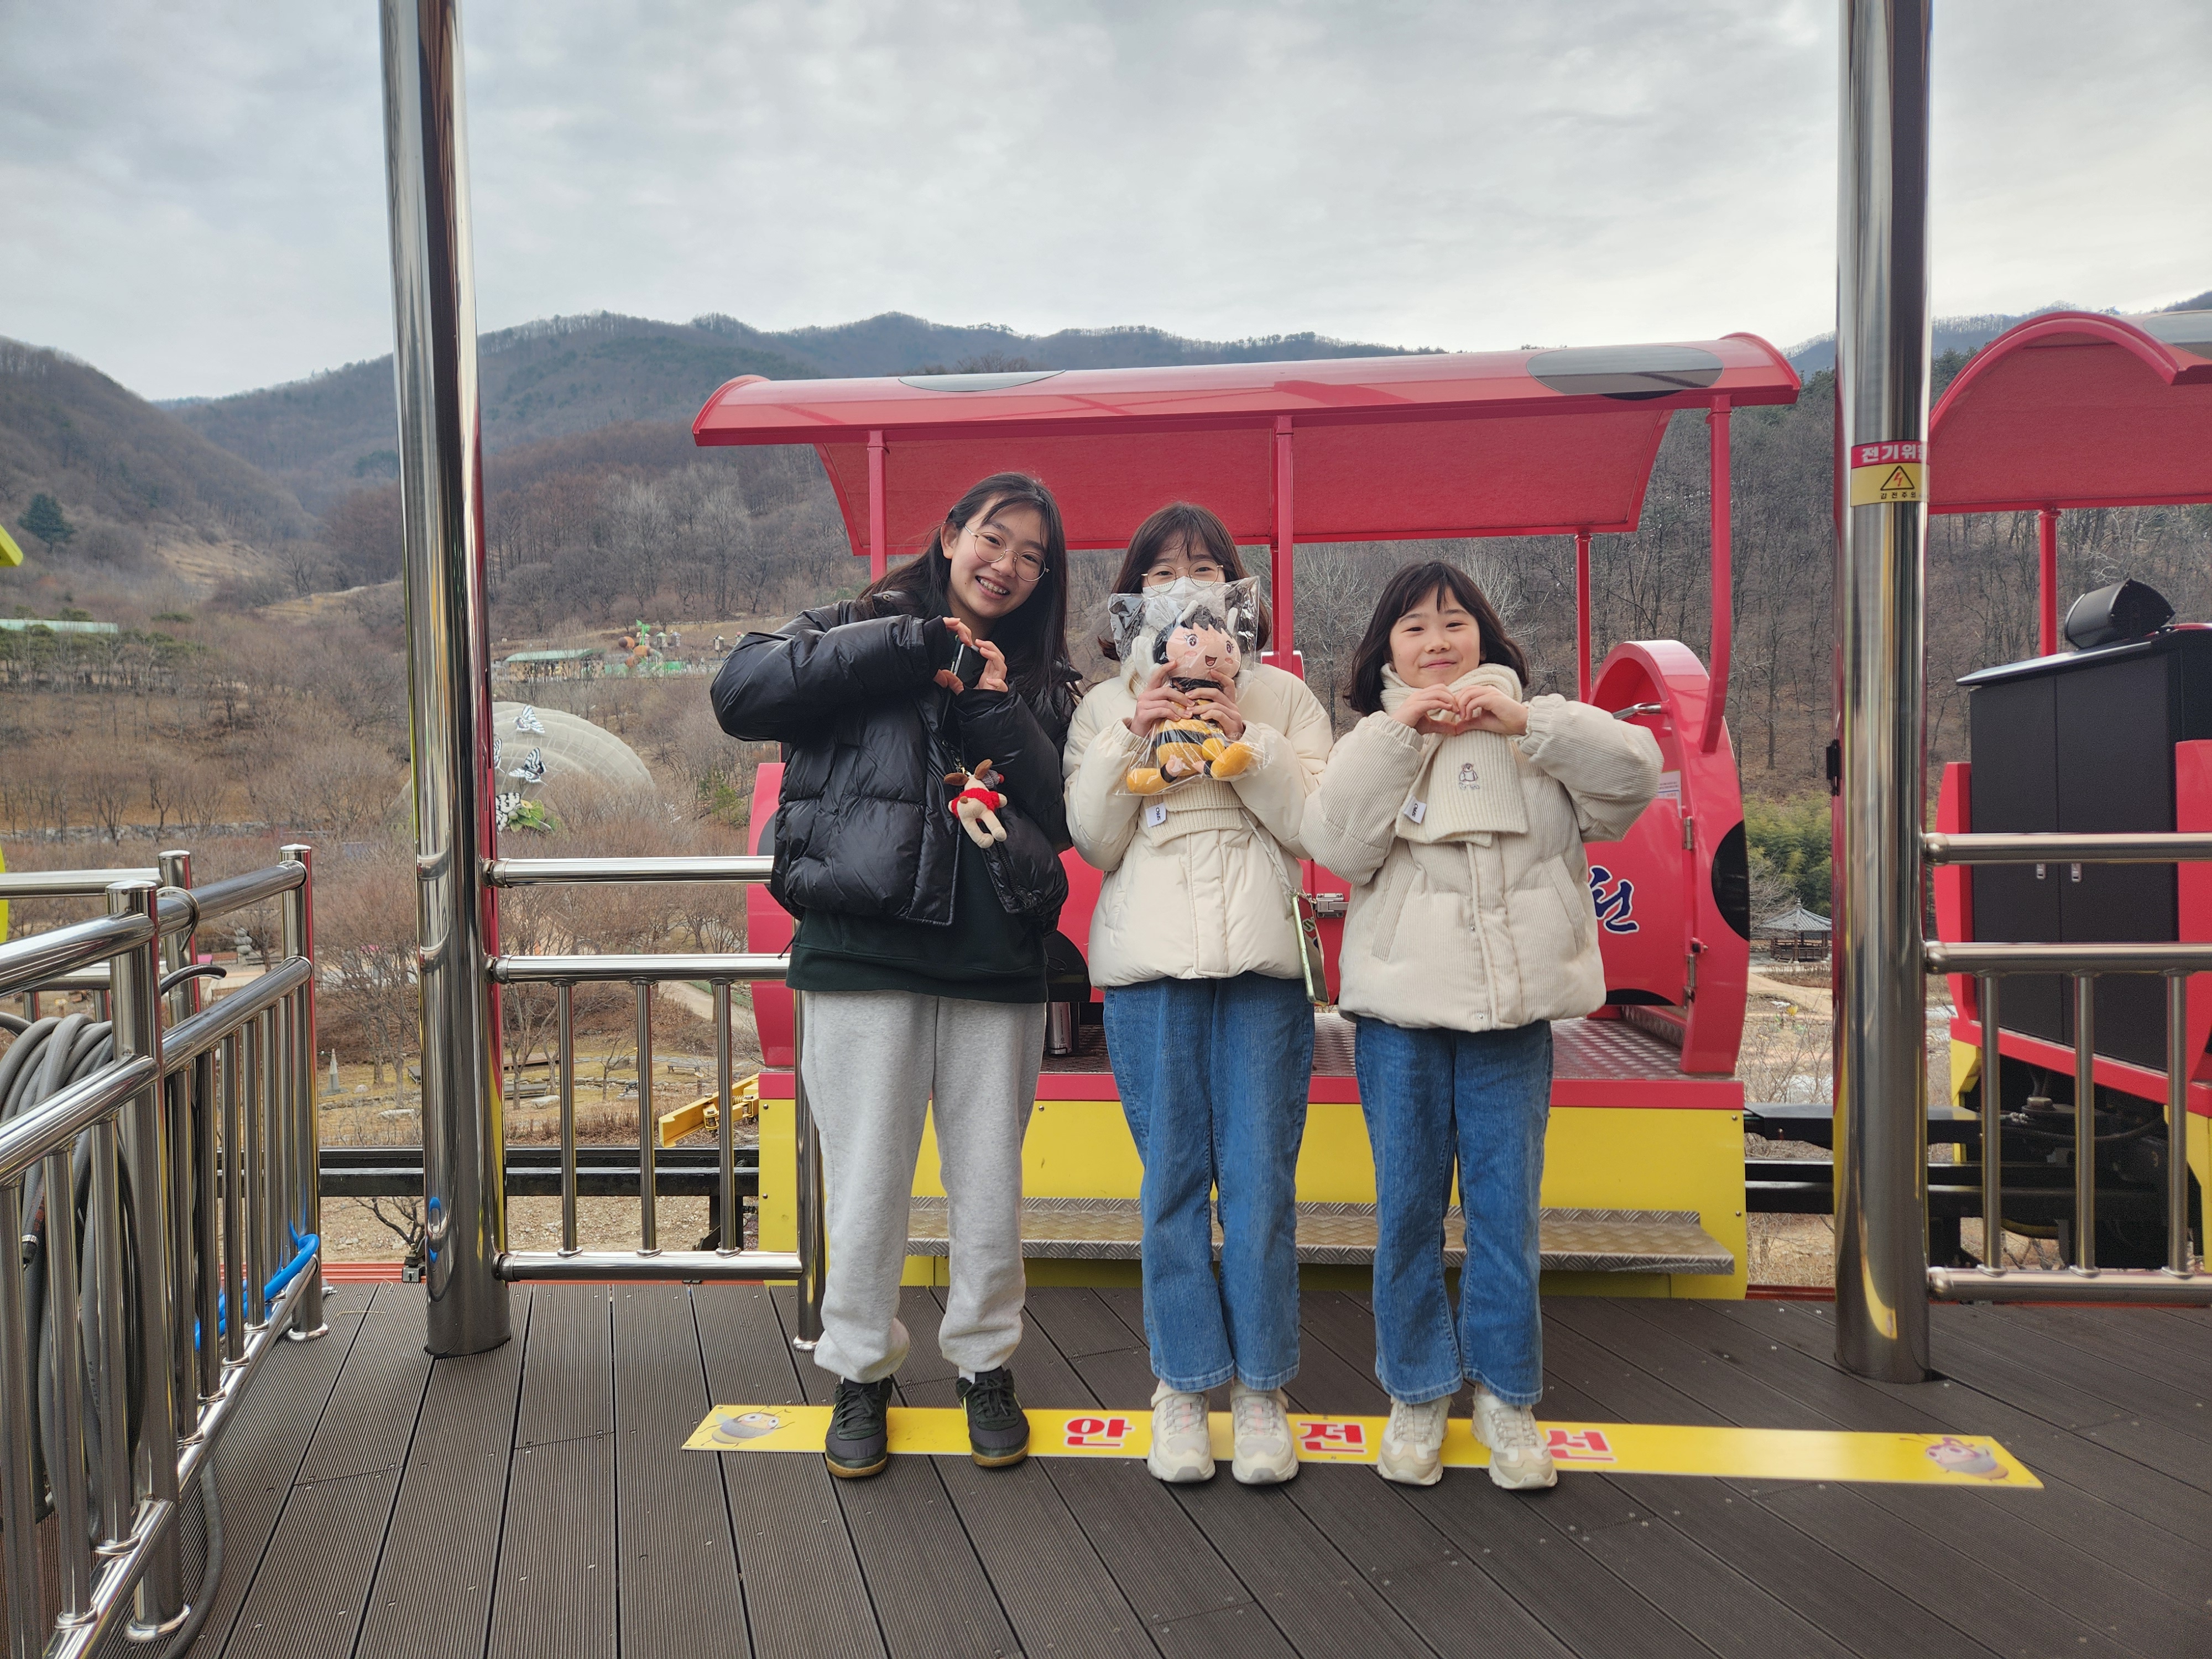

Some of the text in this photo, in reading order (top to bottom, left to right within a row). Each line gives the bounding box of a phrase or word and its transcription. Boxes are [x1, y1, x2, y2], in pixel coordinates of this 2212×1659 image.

[1066, 1417, 1615, 1462] 안 전 선
